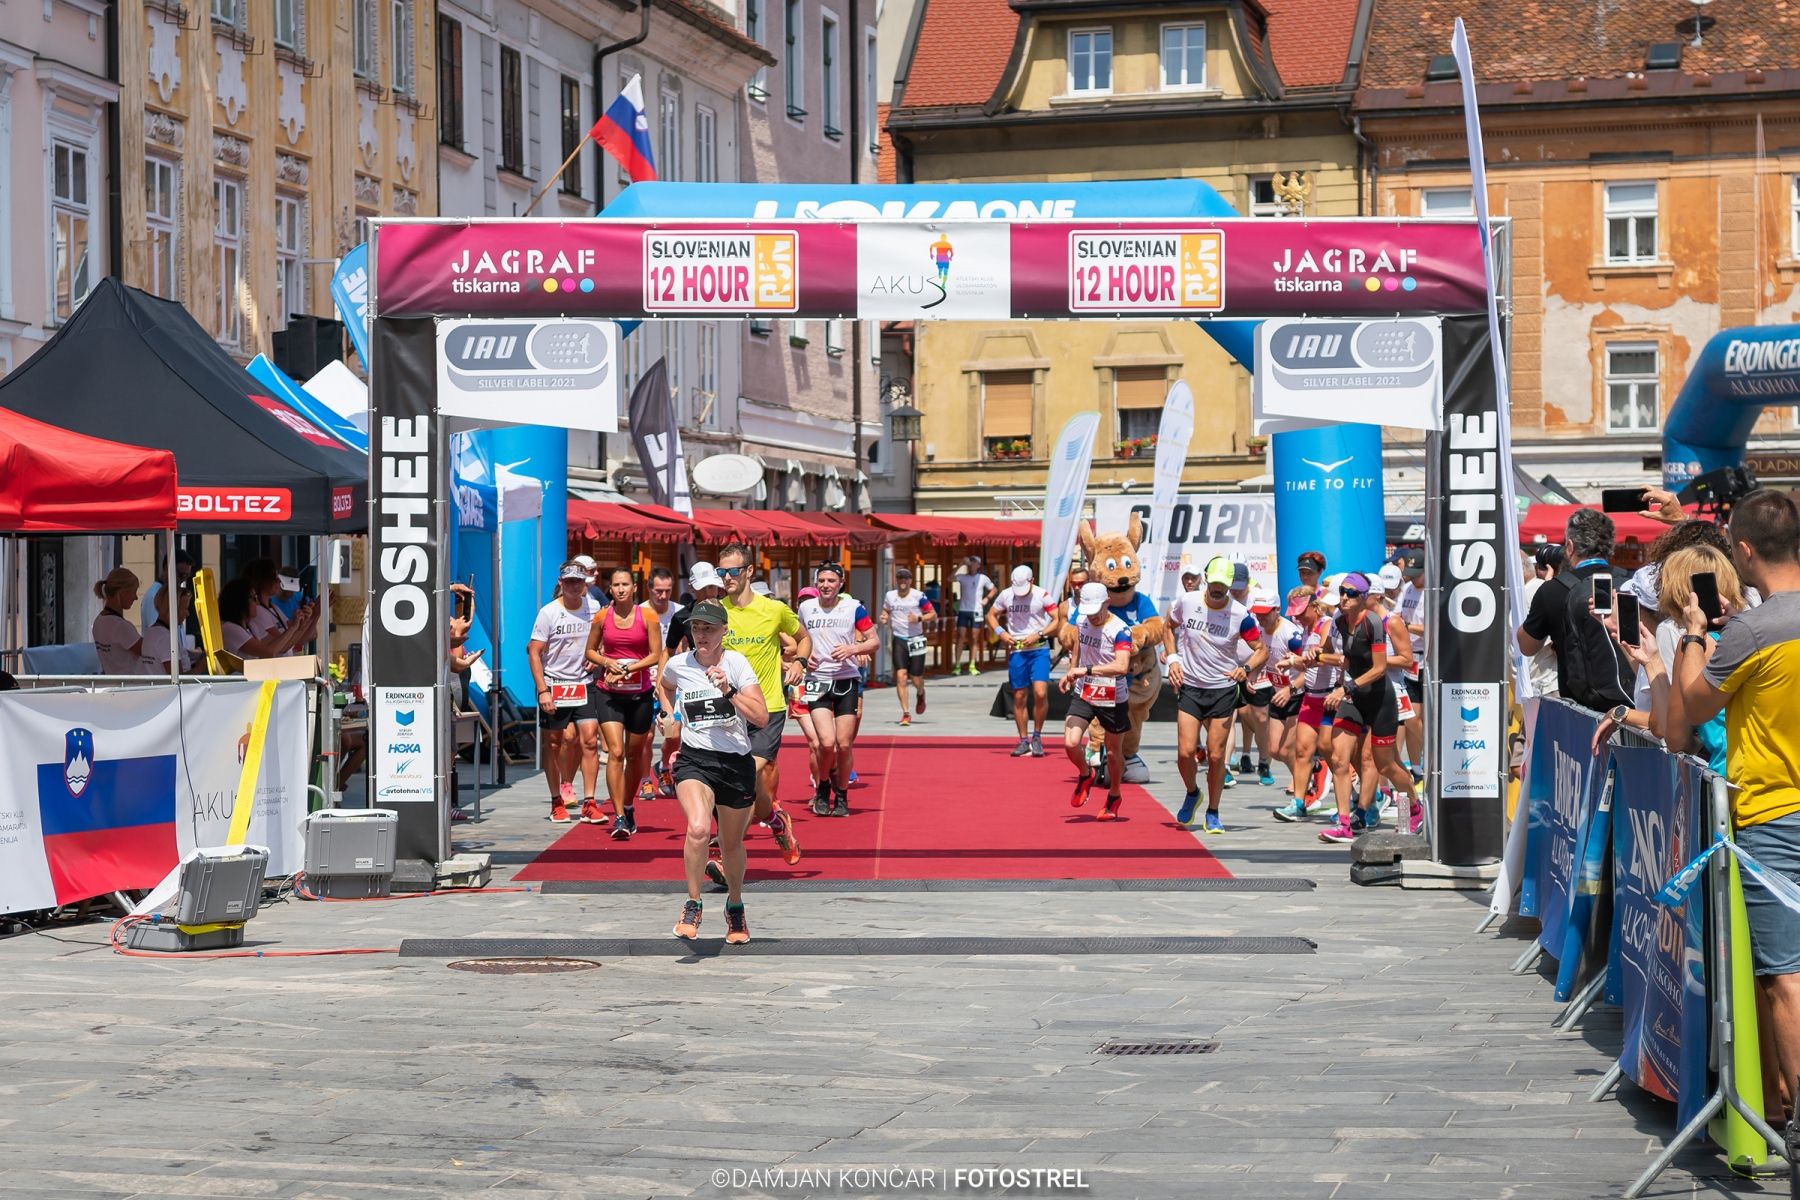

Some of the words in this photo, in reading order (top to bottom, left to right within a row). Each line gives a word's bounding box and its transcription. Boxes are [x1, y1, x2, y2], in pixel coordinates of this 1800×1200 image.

[652, 240, 751, 259] SLOVENIAN
[1078, 240, 1177, 259] SLOVENIAN
[451, 249, 595, 274] JAGRAF
[1273, 248, 1417, 273] JAGRAF
[452, 277, 520, 293] tiskarna
[651, 265, 675, 302] 12
[683, 264, 750, 303] HOUR
[1076, 265, 1101, 302] 12
[1108, 264, 1176, 303] HOUR
[1274, 276, 1343, 292] tiskarna
[462, 336, 518, 360] IAU
[1286, 333, 1343, 359] IAU
[478, 379, 514, 389] SILVER
[516, 378, 548, 389] LABEL
[550, 378, 576, 388] 2021
[1302, 376, 1339, 387] SILVER
[1341, 376, 1374, 387] LABEL
[1375, 375, 1402, 387] 2021
[1286, 480, 1316, 491] TIME
[1324, 478, 1345, 490] TO
[1353, 478, 1374, 489] FLY
[177, 495, 281, 513] BOLTEZ
[380, 415, 429, 637] OSHEE
[1448, 410, 1497, 633] OSHEE
[386, 692, 416, 700] ERDINGER
[561, 686, 577, 696] 77
[1090, 686, 1106, 697] 74
[704, 700, 716, 713] 5
[388, 743, 421, 753] HOKA
[1453, 739, 1486, 750] HOKA
